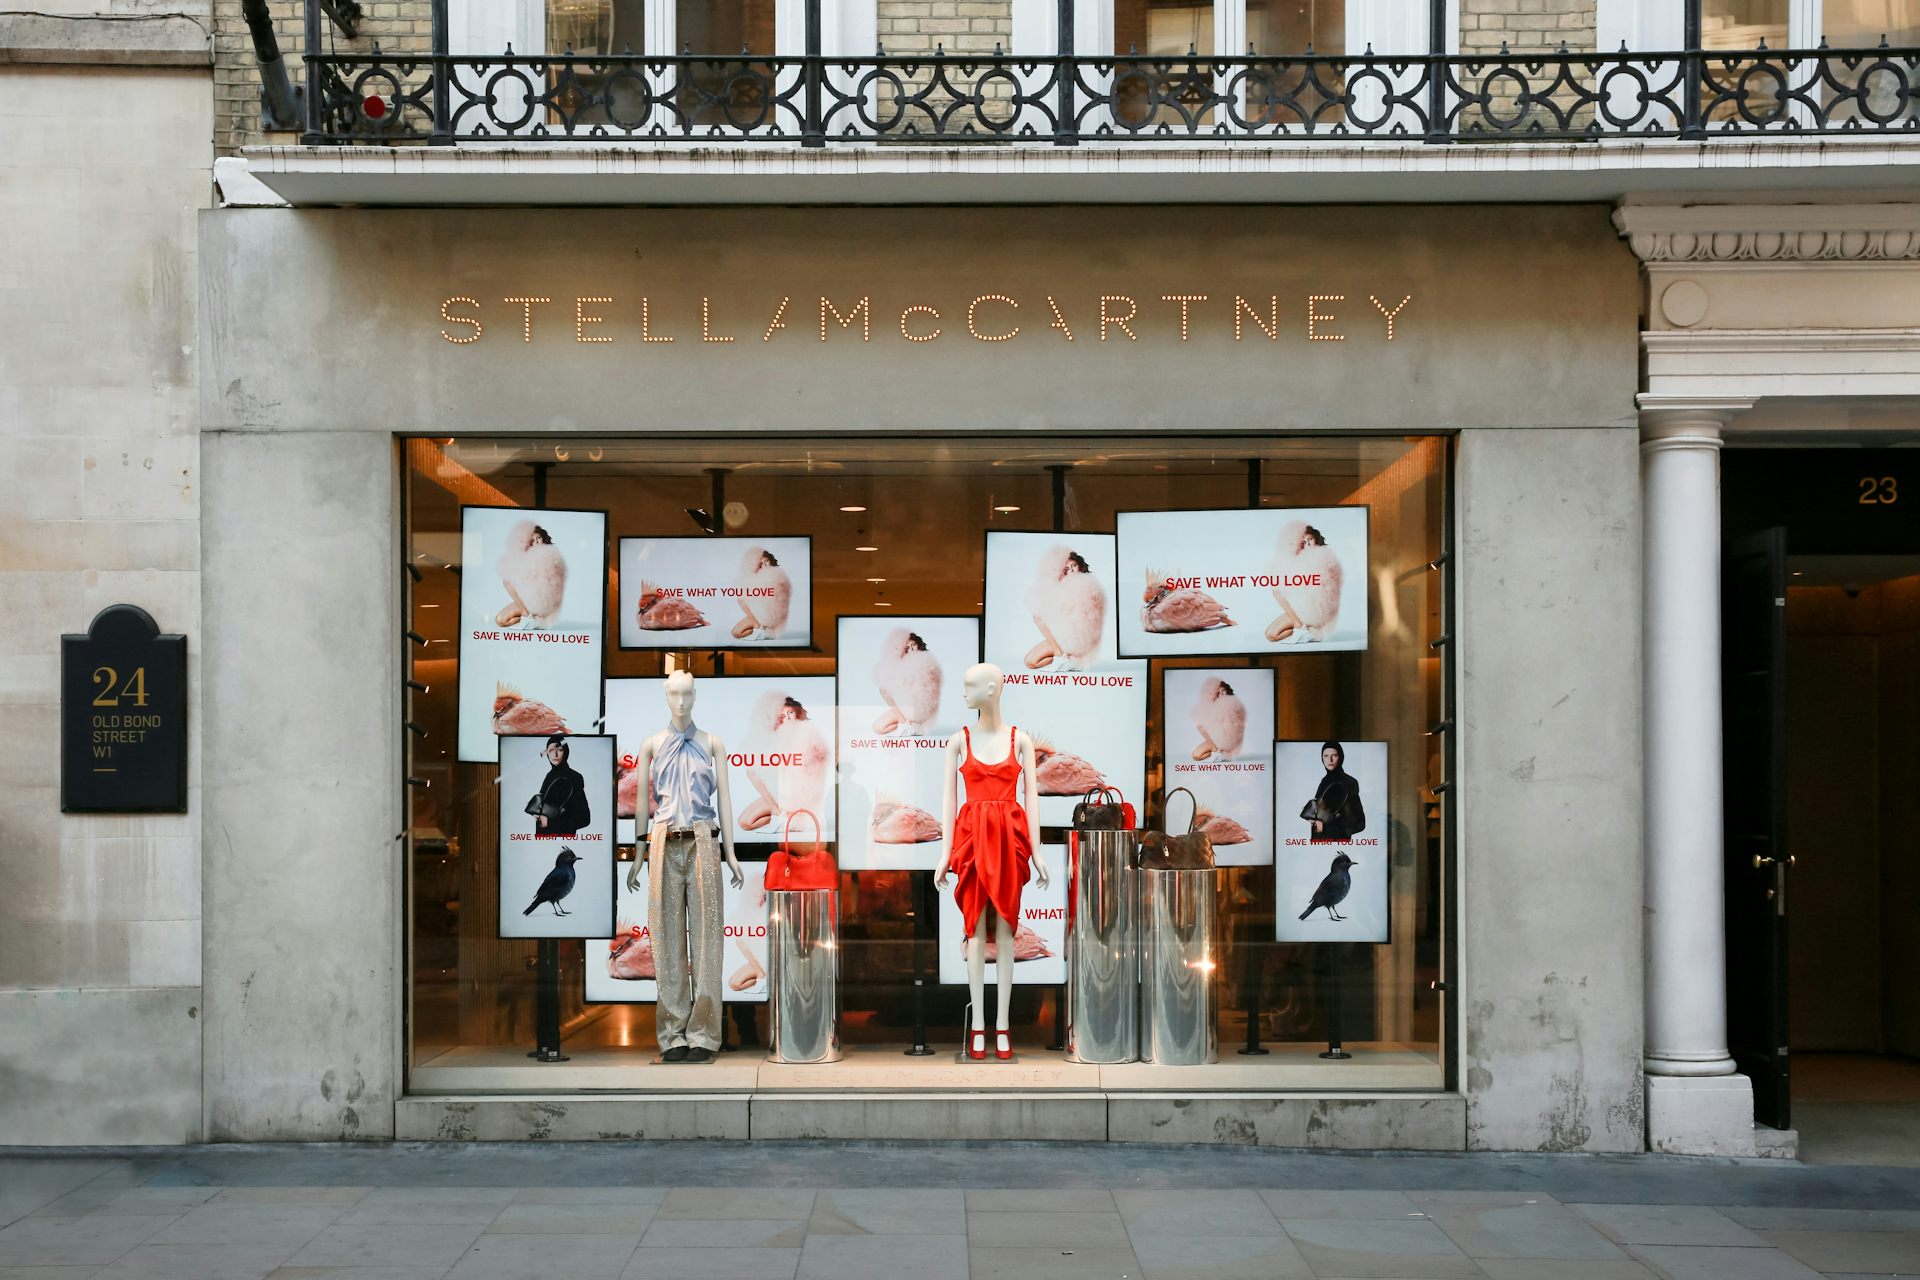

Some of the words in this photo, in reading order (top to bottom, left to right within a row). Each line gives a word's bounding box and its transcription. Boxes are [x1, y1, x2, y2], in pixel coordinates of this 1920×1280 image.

[441, 296, 790, 344] STELLA
[1858, 476, 1898, 505] 23
[1165, 577, 1201, 590] SAVE
[1205, 576, 1246, 588] WHAT
[1250, 575, 1279, 587] YOU
[1284, 574, 1321, 586] LOVE
[656, 588, 683, 598] SAVE
[686, 588, 717, 597] WHAT
[720, 588, 743, 597] YOU
[746, 587, 774, 597] LOVE
[473, 631, 500, 641] SAVE
[503, 632, 533, 642] WHAT
[536, 633, 559, 643] YOU
[562, 634, 590, 644] LOVE
[92, 666, 150, 706] 24
[1033, 675, 1068, 685] WHAT
[1071, 676, 1097, 686] YOU
[1101, 676, 1133, 687] LOVE
[92, 715, 120, 728] OLD
[123, 715, 161, 728] BOND
[92, 730, 146, 743] STREET
[850, 739, 877, 748] SAVE
[881, 739, 911, 748] WHAT
[914, 739, 936, 748] YOU
[92, 746, 112, 758] W1
[760, 753, 802, 767] LOVE
[1174, 764, 1196, 772] SAVE
[1198, 764, 1222, 772] WHAT
[1224, 763, 1242, 771] YOU
[1243, 763, 1265, 771] LOVE
[510, 833, 532, 841] SAVE
[534, 833, 558, 841] WHAT
[561, 833, 579, 841] YOU
[581, 833, 603, 841] LOVE
[1285, 838, 1307, 846] SAVE
[1309, 838, 1333, 846] WHAT
[1336, 838, 1354, 846] YOU
[1356, 838, 1378, 846] LOVE
[1025, 908, 1064, 920] WHAT
[632, 925, 650, 938] SA
[723, 925, 743, 937] OU
[748, 925, 766, 937] LO
